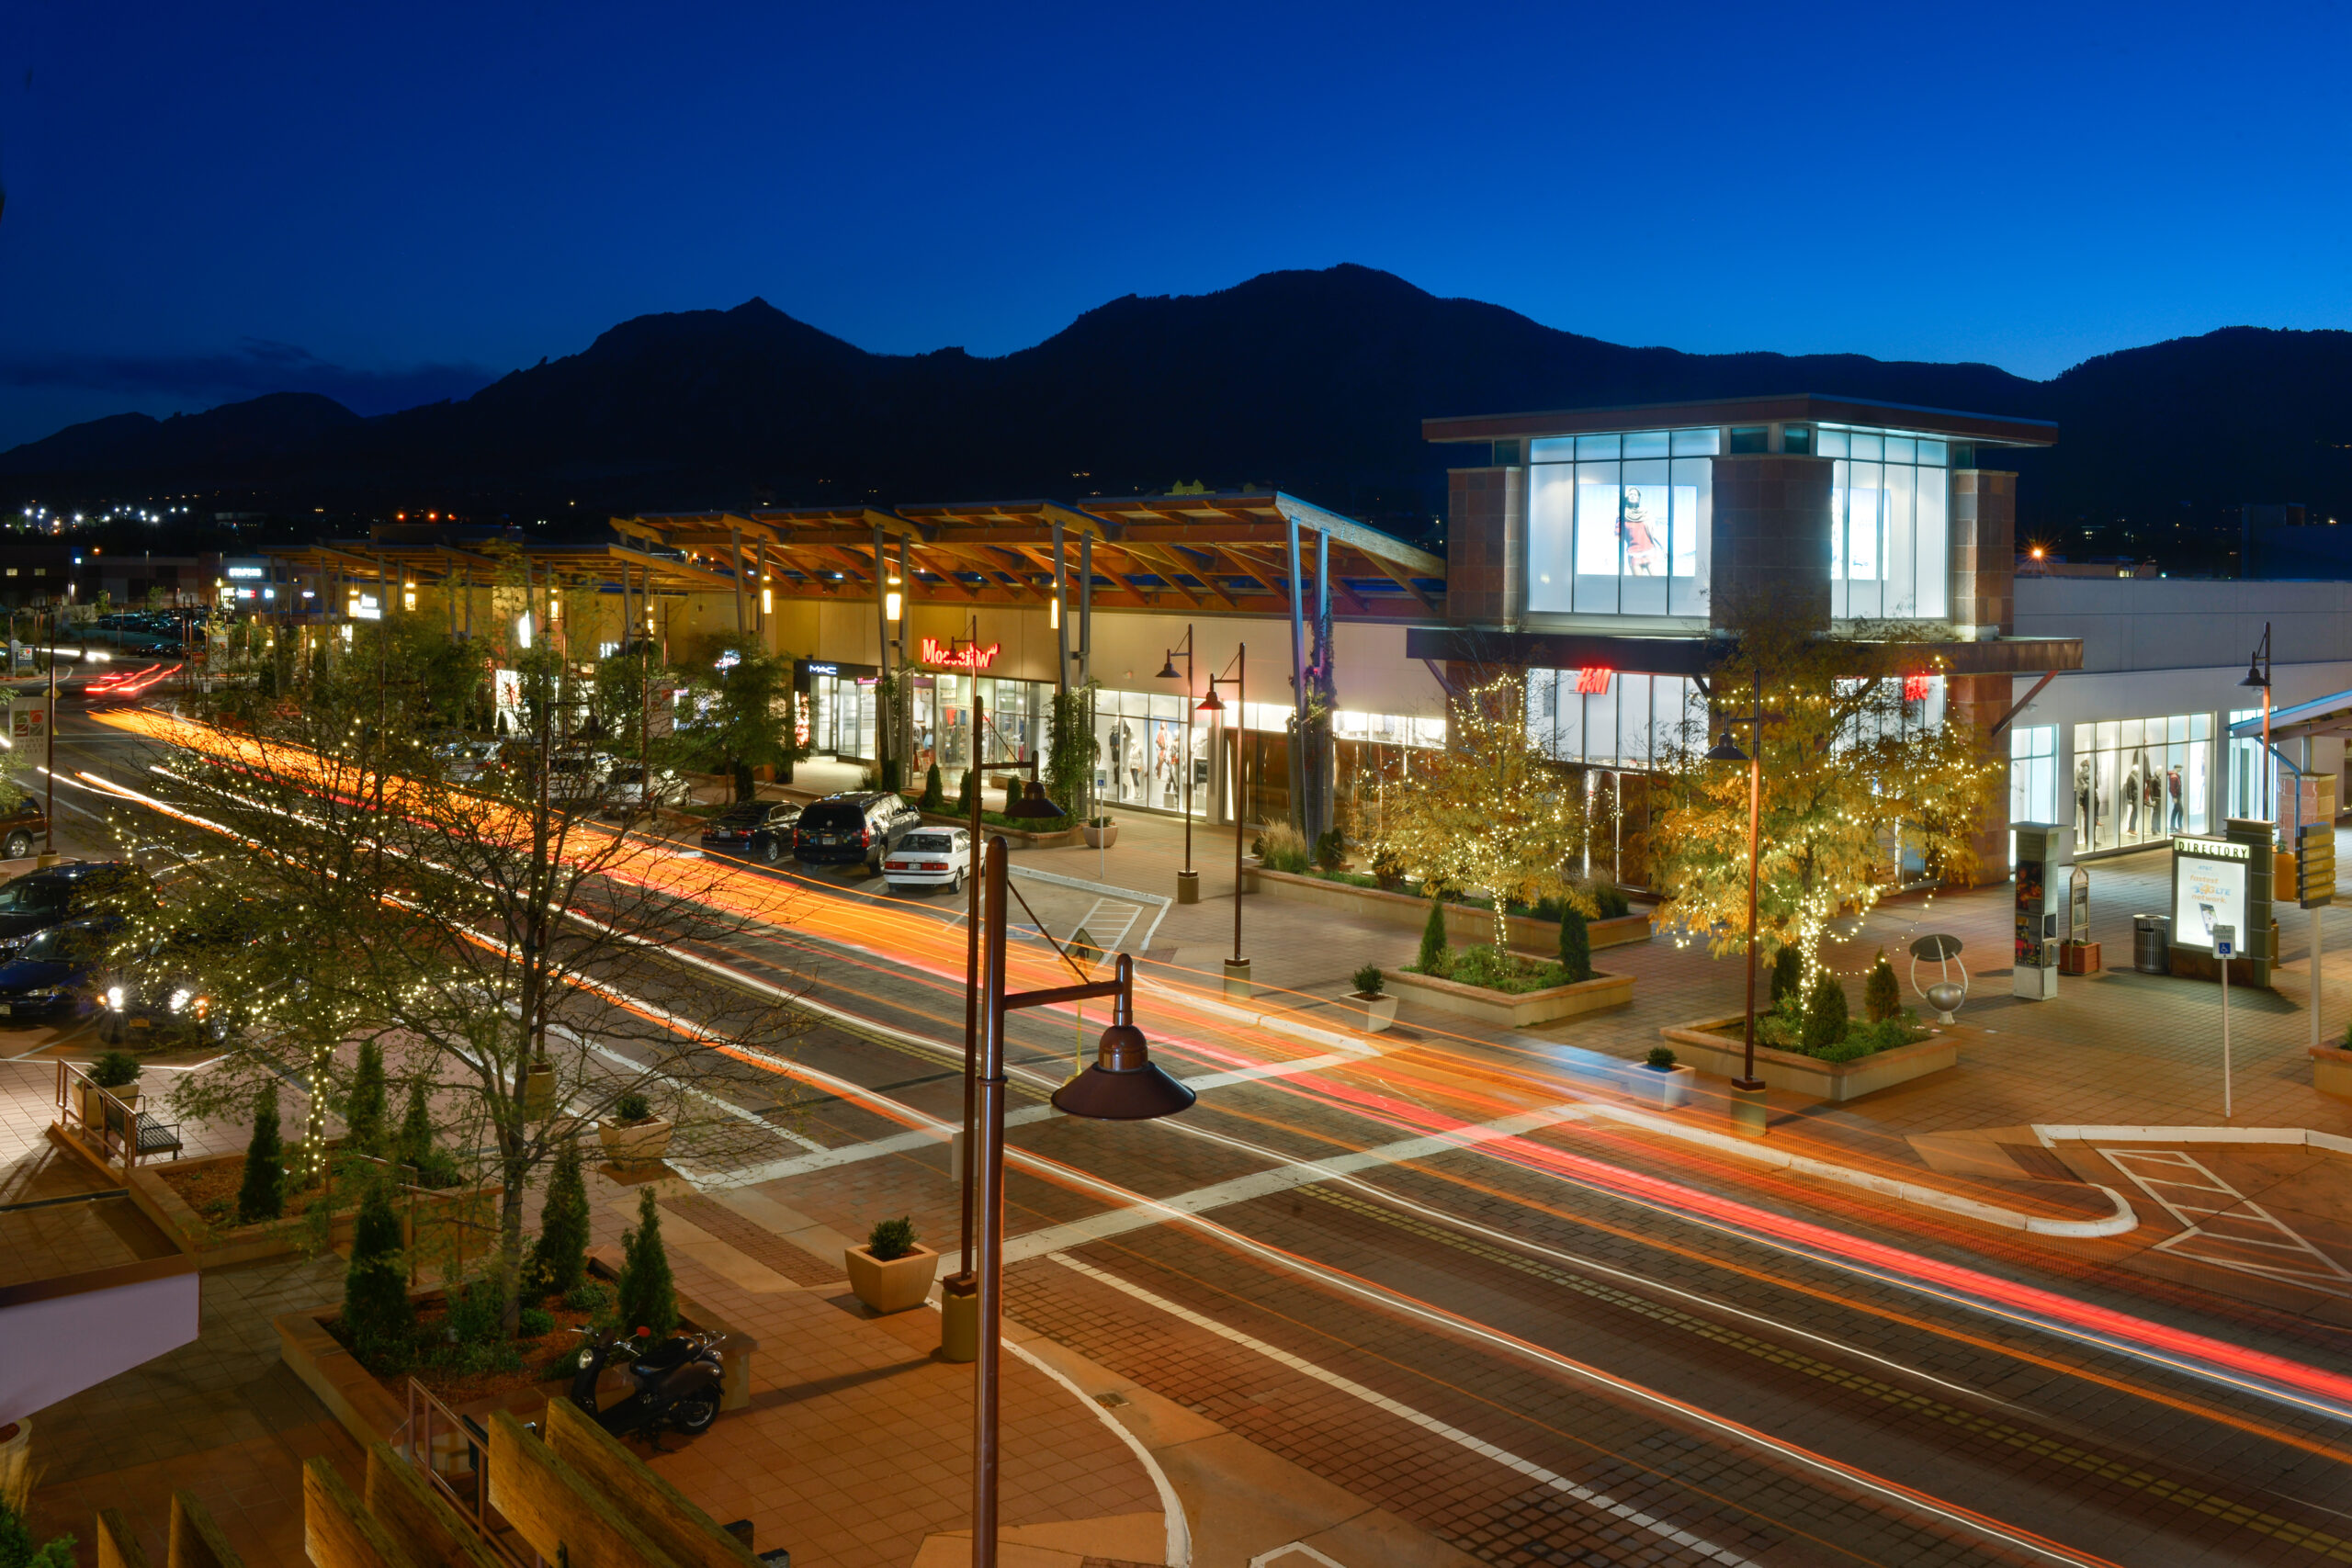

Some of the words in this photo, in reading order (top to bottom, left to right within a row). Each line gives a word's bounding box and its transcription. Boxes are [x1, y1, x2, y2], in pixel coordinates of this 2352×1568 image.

[808, 664, 837, 675] MAC
[1575, 667, 1611, 695] H&M
[2178, 841, 2247, 859] DIRECTORY
[2190, 874, 2219, 884] fastest
